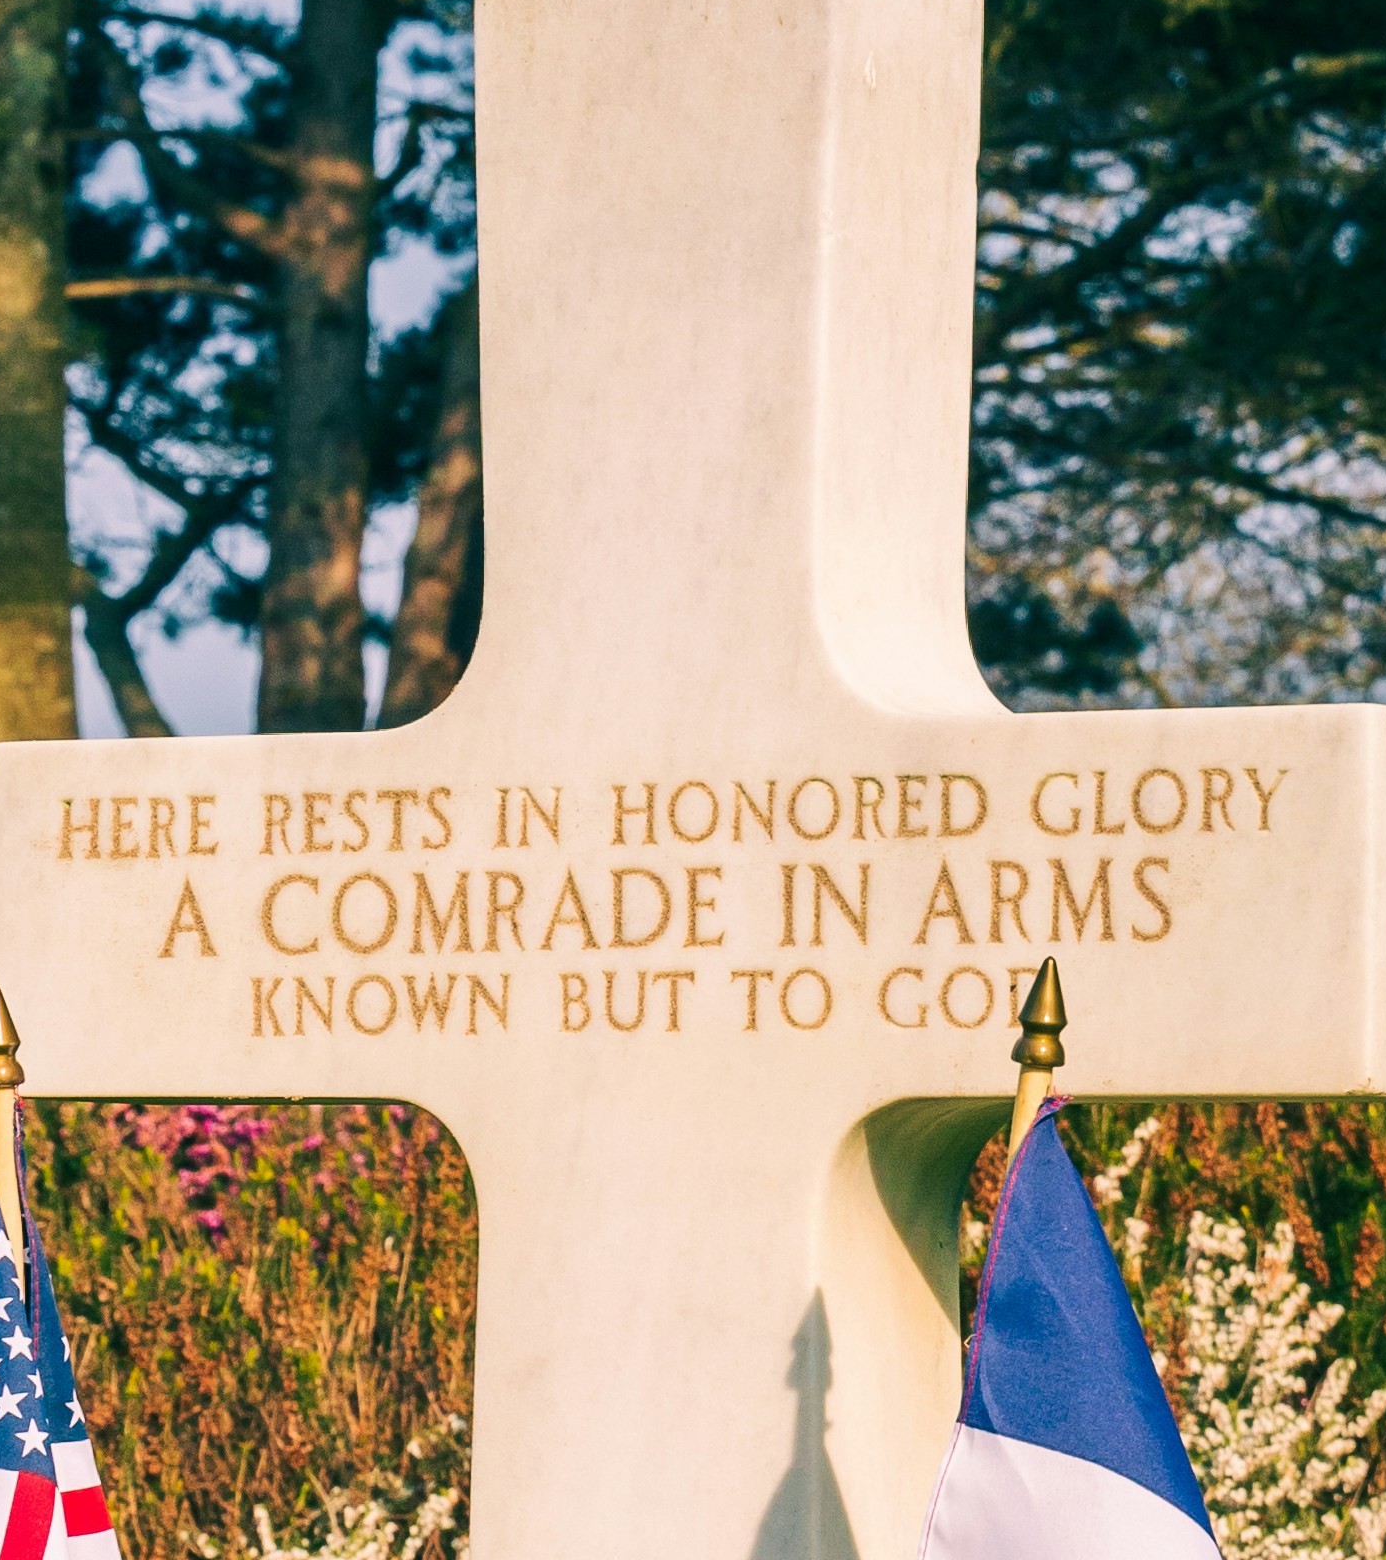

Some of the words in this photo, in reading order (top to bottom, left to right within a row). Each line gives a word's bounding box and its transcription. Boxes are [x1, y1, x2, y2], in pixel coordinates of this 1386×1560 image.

[57, 793, 218, 859] HERE
[259, 786, 452, 855] RESTS
[493, 786, 563, 850] IN
[609, 773, 988, 847] HONORED
[1030, 766, 1290, 836] GLORY
[157, 874, 219, 959] A
[258, 864, 725, 956] COMRADE
[778, 862, 872, 948] IN
[912, 856, 1173, 946] ARMS
[250, 972, 510, 1037] KNOWN
[558, 970, 695, 1033] BUT
[730, 966, 833, 1032] TO
